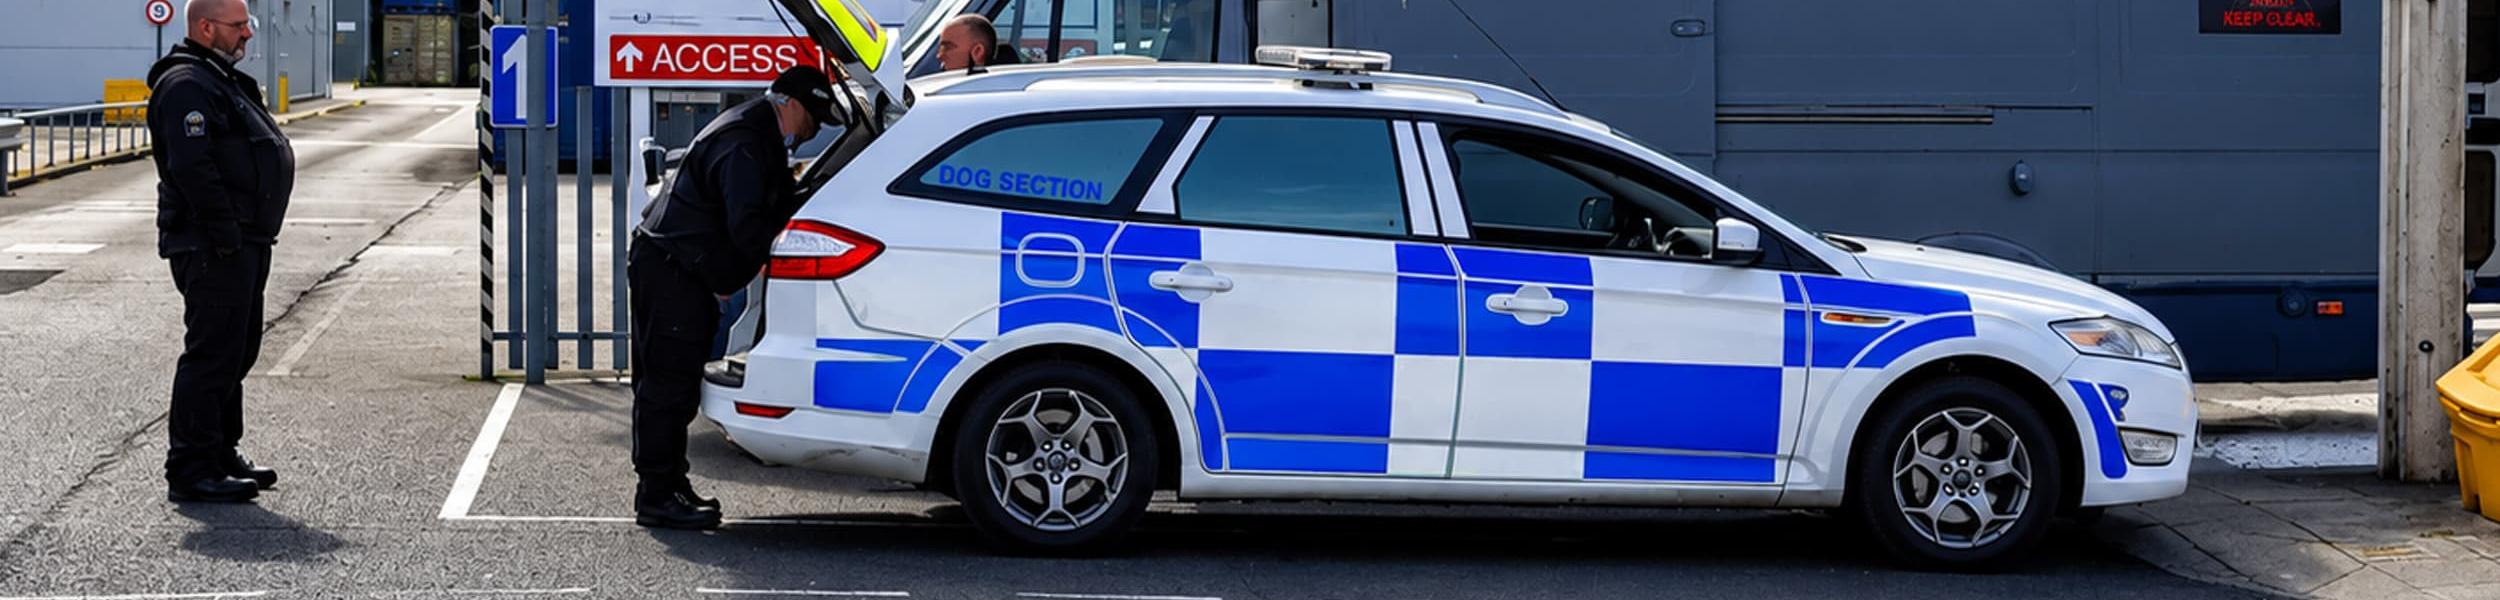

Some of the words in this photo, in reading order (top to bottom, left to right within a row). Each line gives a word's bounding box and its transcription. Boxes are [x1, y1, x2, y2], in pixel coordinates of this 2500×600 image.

[154, 4, 165, 18] 9
[2224, 11, 2263, 26] KEEP
[652, 43, 797, 73] ACCESS
[502, 33, 527, 119] 1
[939, 165, 991, 189] DOG
[999, 171, 1103, 200] SECTION
